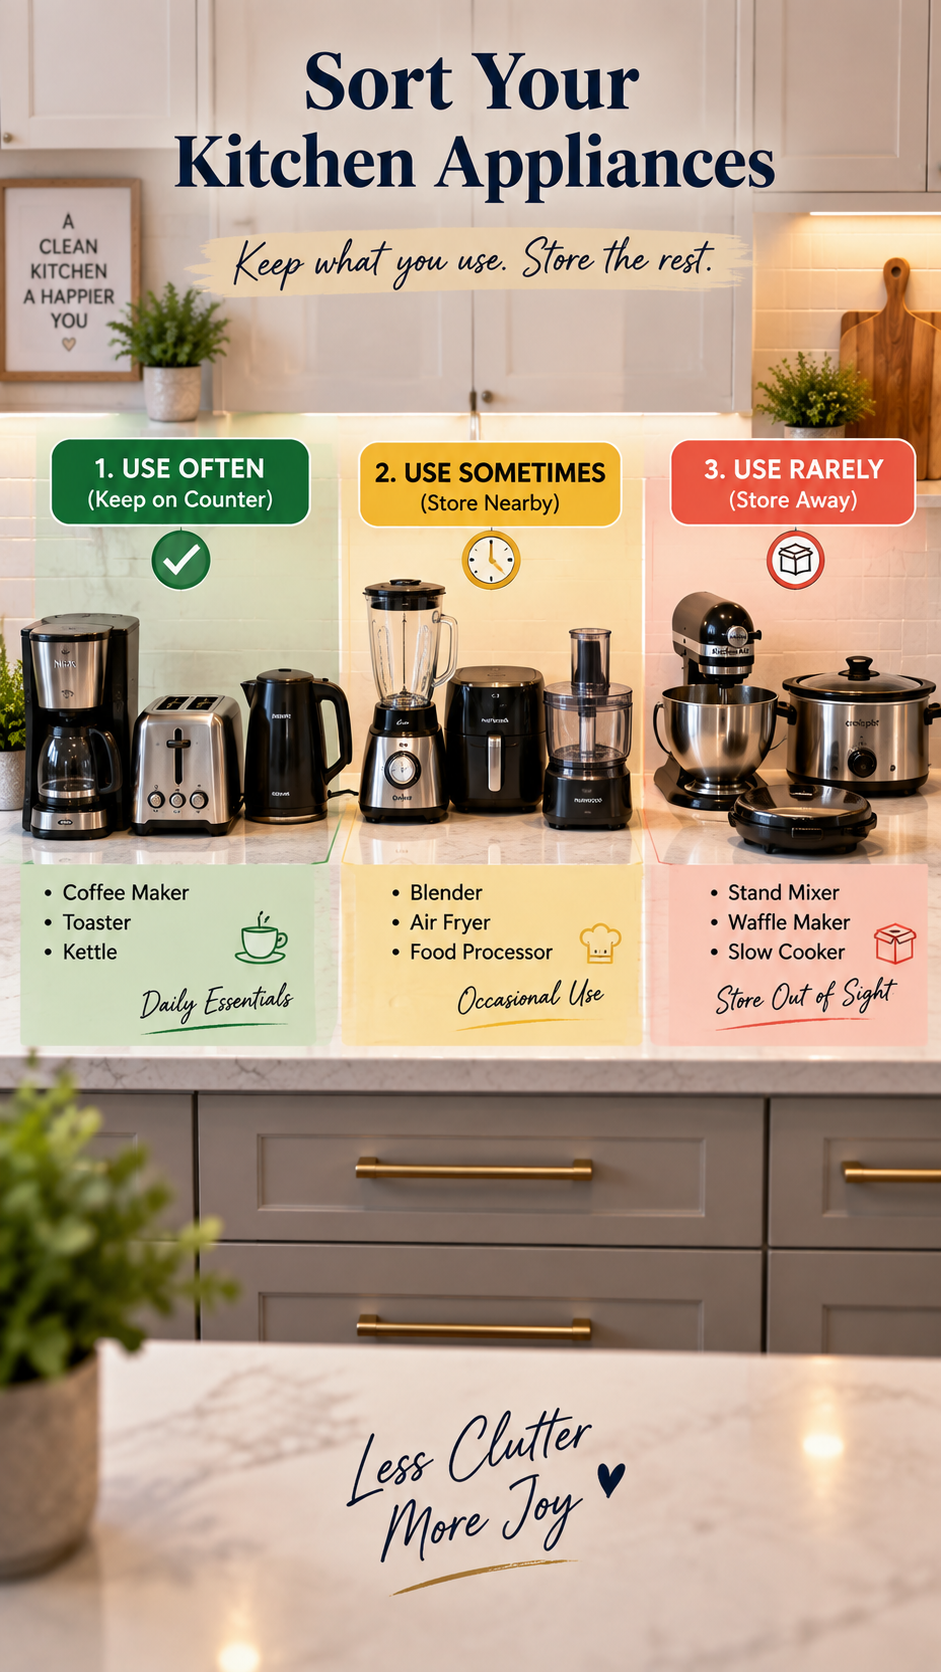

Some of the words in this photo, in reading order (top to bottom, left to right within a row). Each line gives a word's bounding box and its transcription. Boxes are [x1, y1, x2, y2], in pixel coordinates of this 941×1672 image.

[63, 214, 74, 228] A
[40, 239, 97, 254] CLEAN
[32, 264, 106, 278] KITCHEN
[24, 290, 35, 303] A
[42, 289, 114, 304] HAPPIER
[51, 313, 87, 328] YOU
